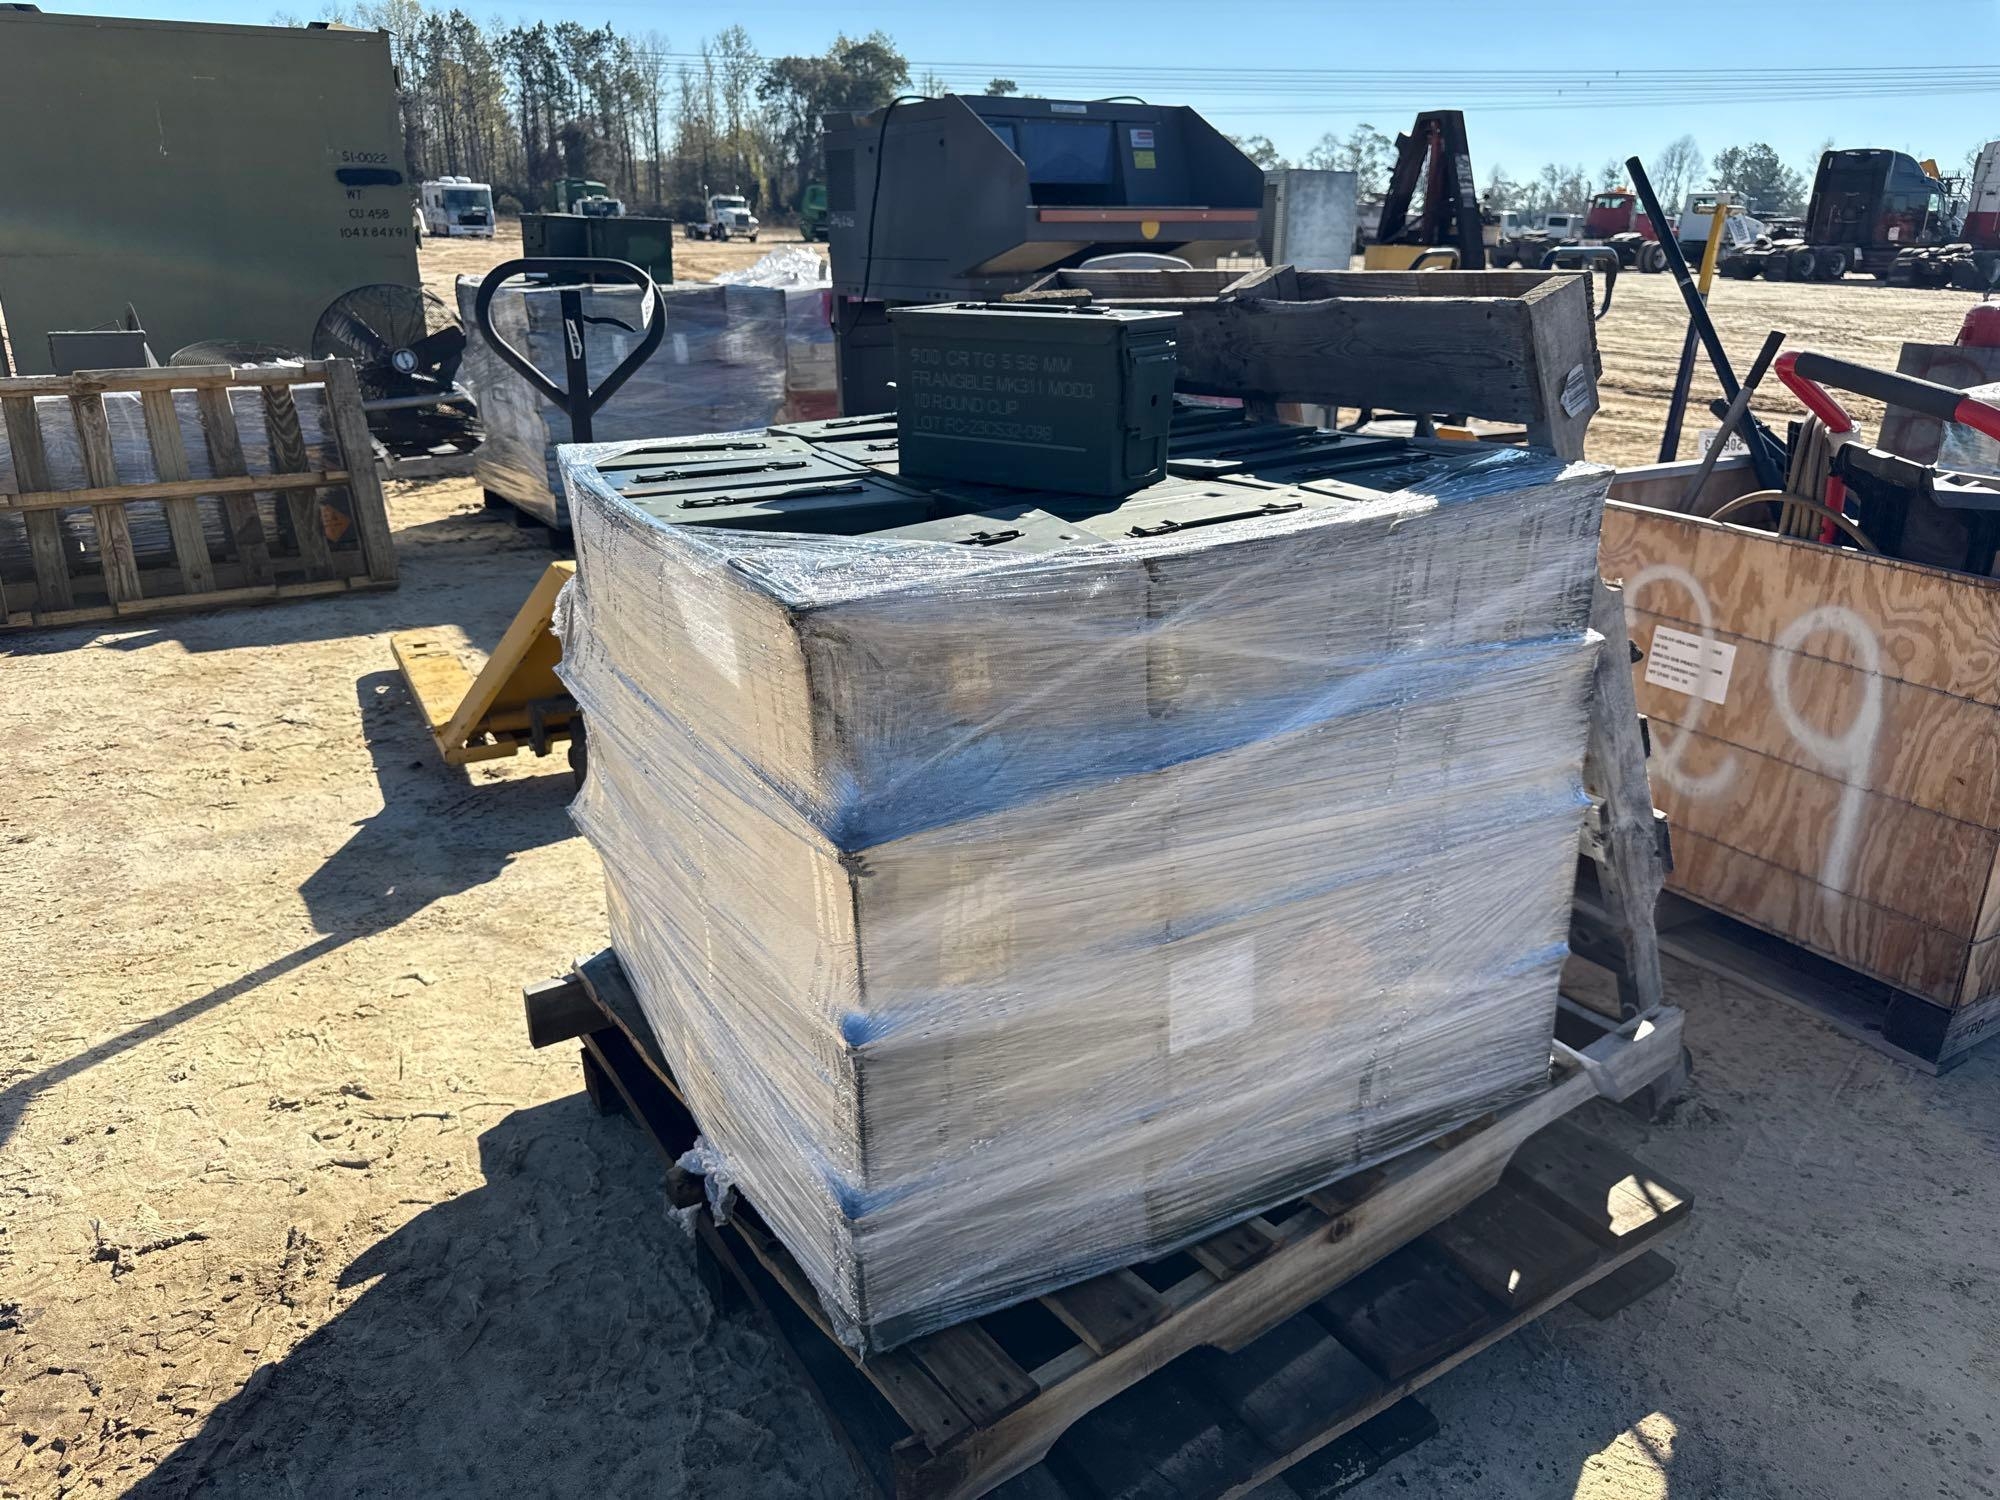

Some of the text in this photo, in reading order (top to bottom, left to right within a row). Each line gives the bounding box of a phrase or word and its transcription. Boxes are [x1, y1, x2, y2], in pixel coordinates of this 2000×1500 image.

[349, 208, 391, 219] CU 458
[931, 393, 984, 413] ROUND
[913, 412, 942, 430] LOT
